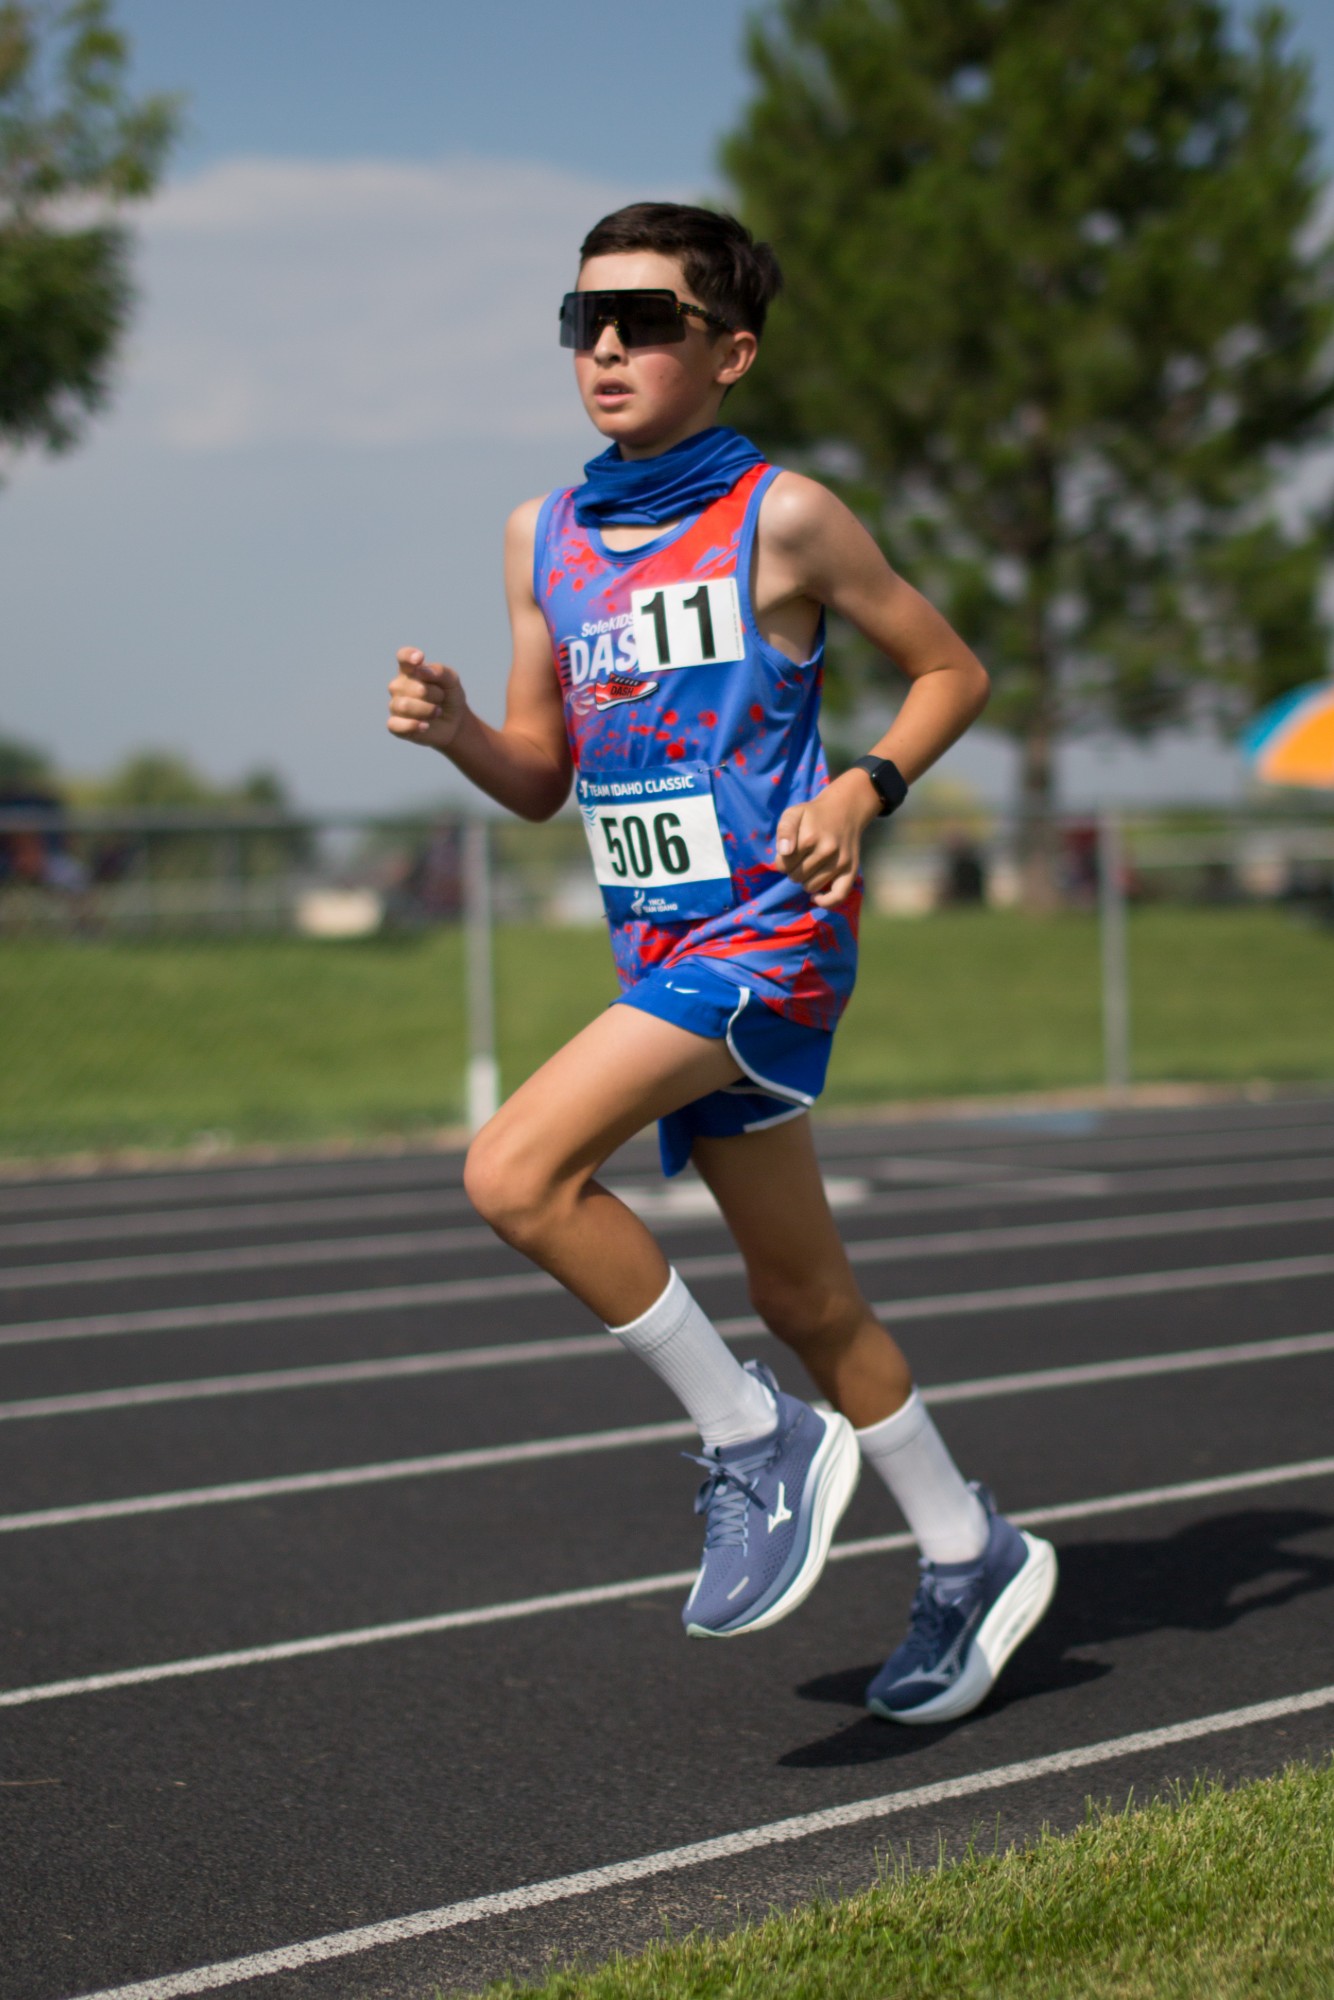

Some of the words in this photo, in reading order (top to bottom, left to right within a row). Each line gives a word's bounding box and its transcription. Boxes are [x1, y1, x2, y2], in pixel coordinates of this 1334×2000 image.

[641, 585, 716, 665] 11
[569, 626, 640, 686] DAS
[610, 685, 634, 697] DASH
[588, 784, 610, 797] TEAM
[610, 781, 643, 796] IDAHO
[645, 775, 695, 794] CLASSIC
[600, 812, 690, 879] 506
